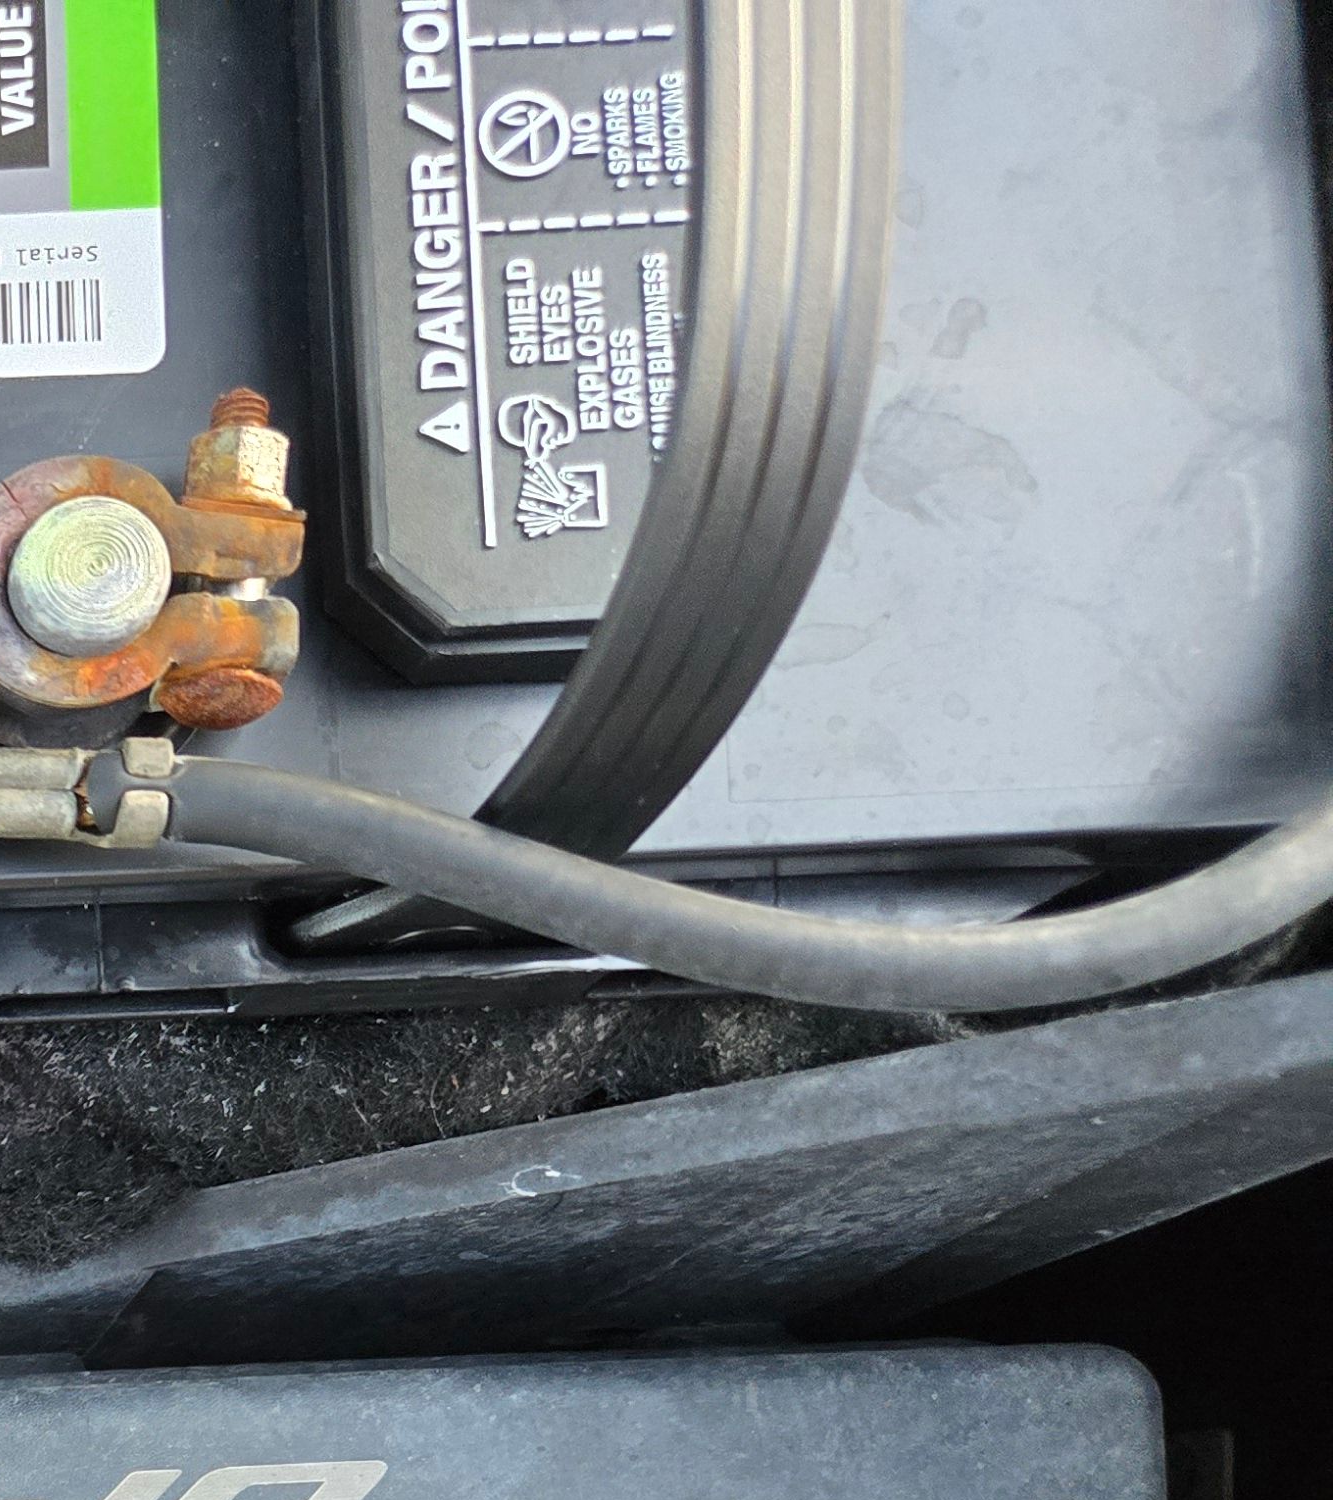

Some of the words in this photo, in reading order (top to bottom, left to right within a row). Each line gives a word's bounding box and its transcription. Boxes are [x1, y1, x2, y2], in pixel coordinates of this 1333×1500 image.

[569, 111, 601, 156] NO
[602, 85, 633, 177] SPARKS
[632, 86, 659, 175] FLAMES
[658, 69, 690, 175] SMOKING
[17, 244, 99, 264] Serial
[409, 152, 469, 390] DANGER
[505, 257, 539, 365] SHIELD
[540, 283, 574, 363] EYES
[572, 265, 611, 431] EXPLOSIVE
[641, 251, 675, 374] BLINDNESS
[609, 327, 645, 430] GASES
